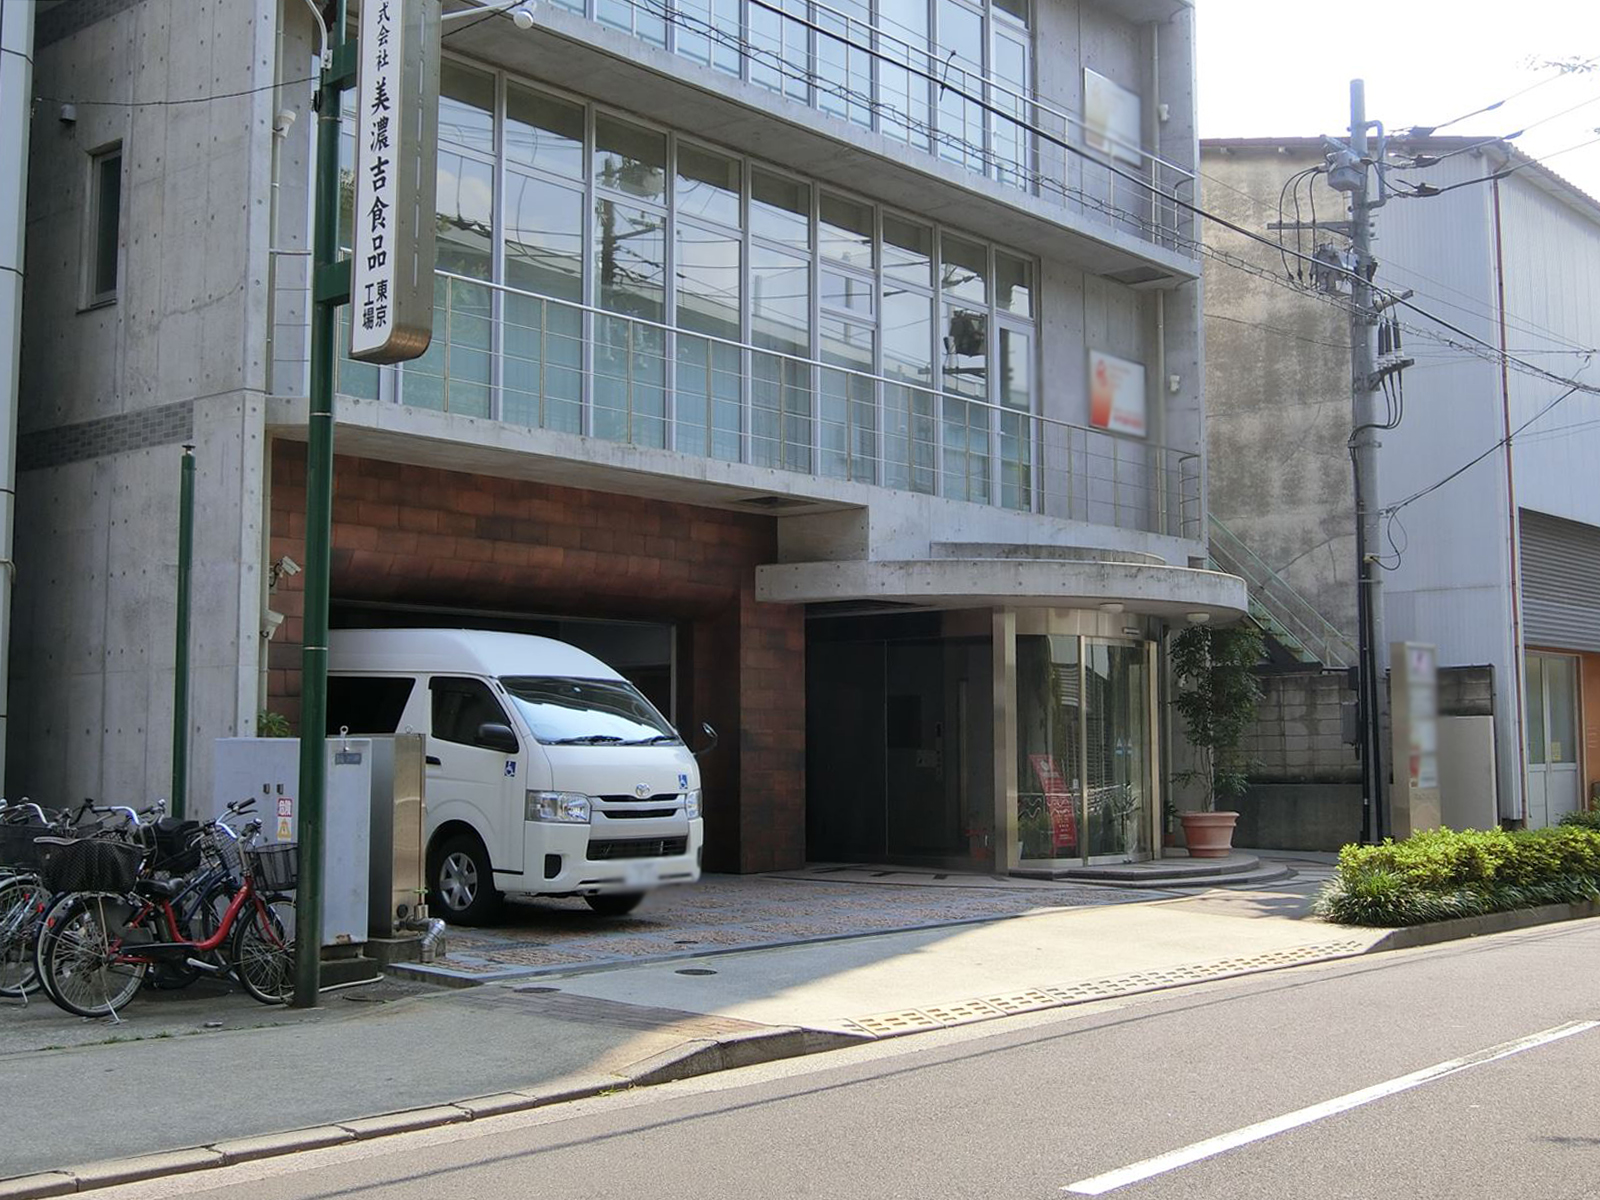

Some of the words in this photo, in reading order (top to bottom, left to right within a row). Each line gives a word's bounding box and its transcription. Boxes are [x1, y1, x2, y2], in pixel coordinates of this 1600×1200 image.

[367, 76, 390, 271] 美濃吉食品
[362, 283, 375, 330] 工場
[375, 279, 388, 328] 東京
